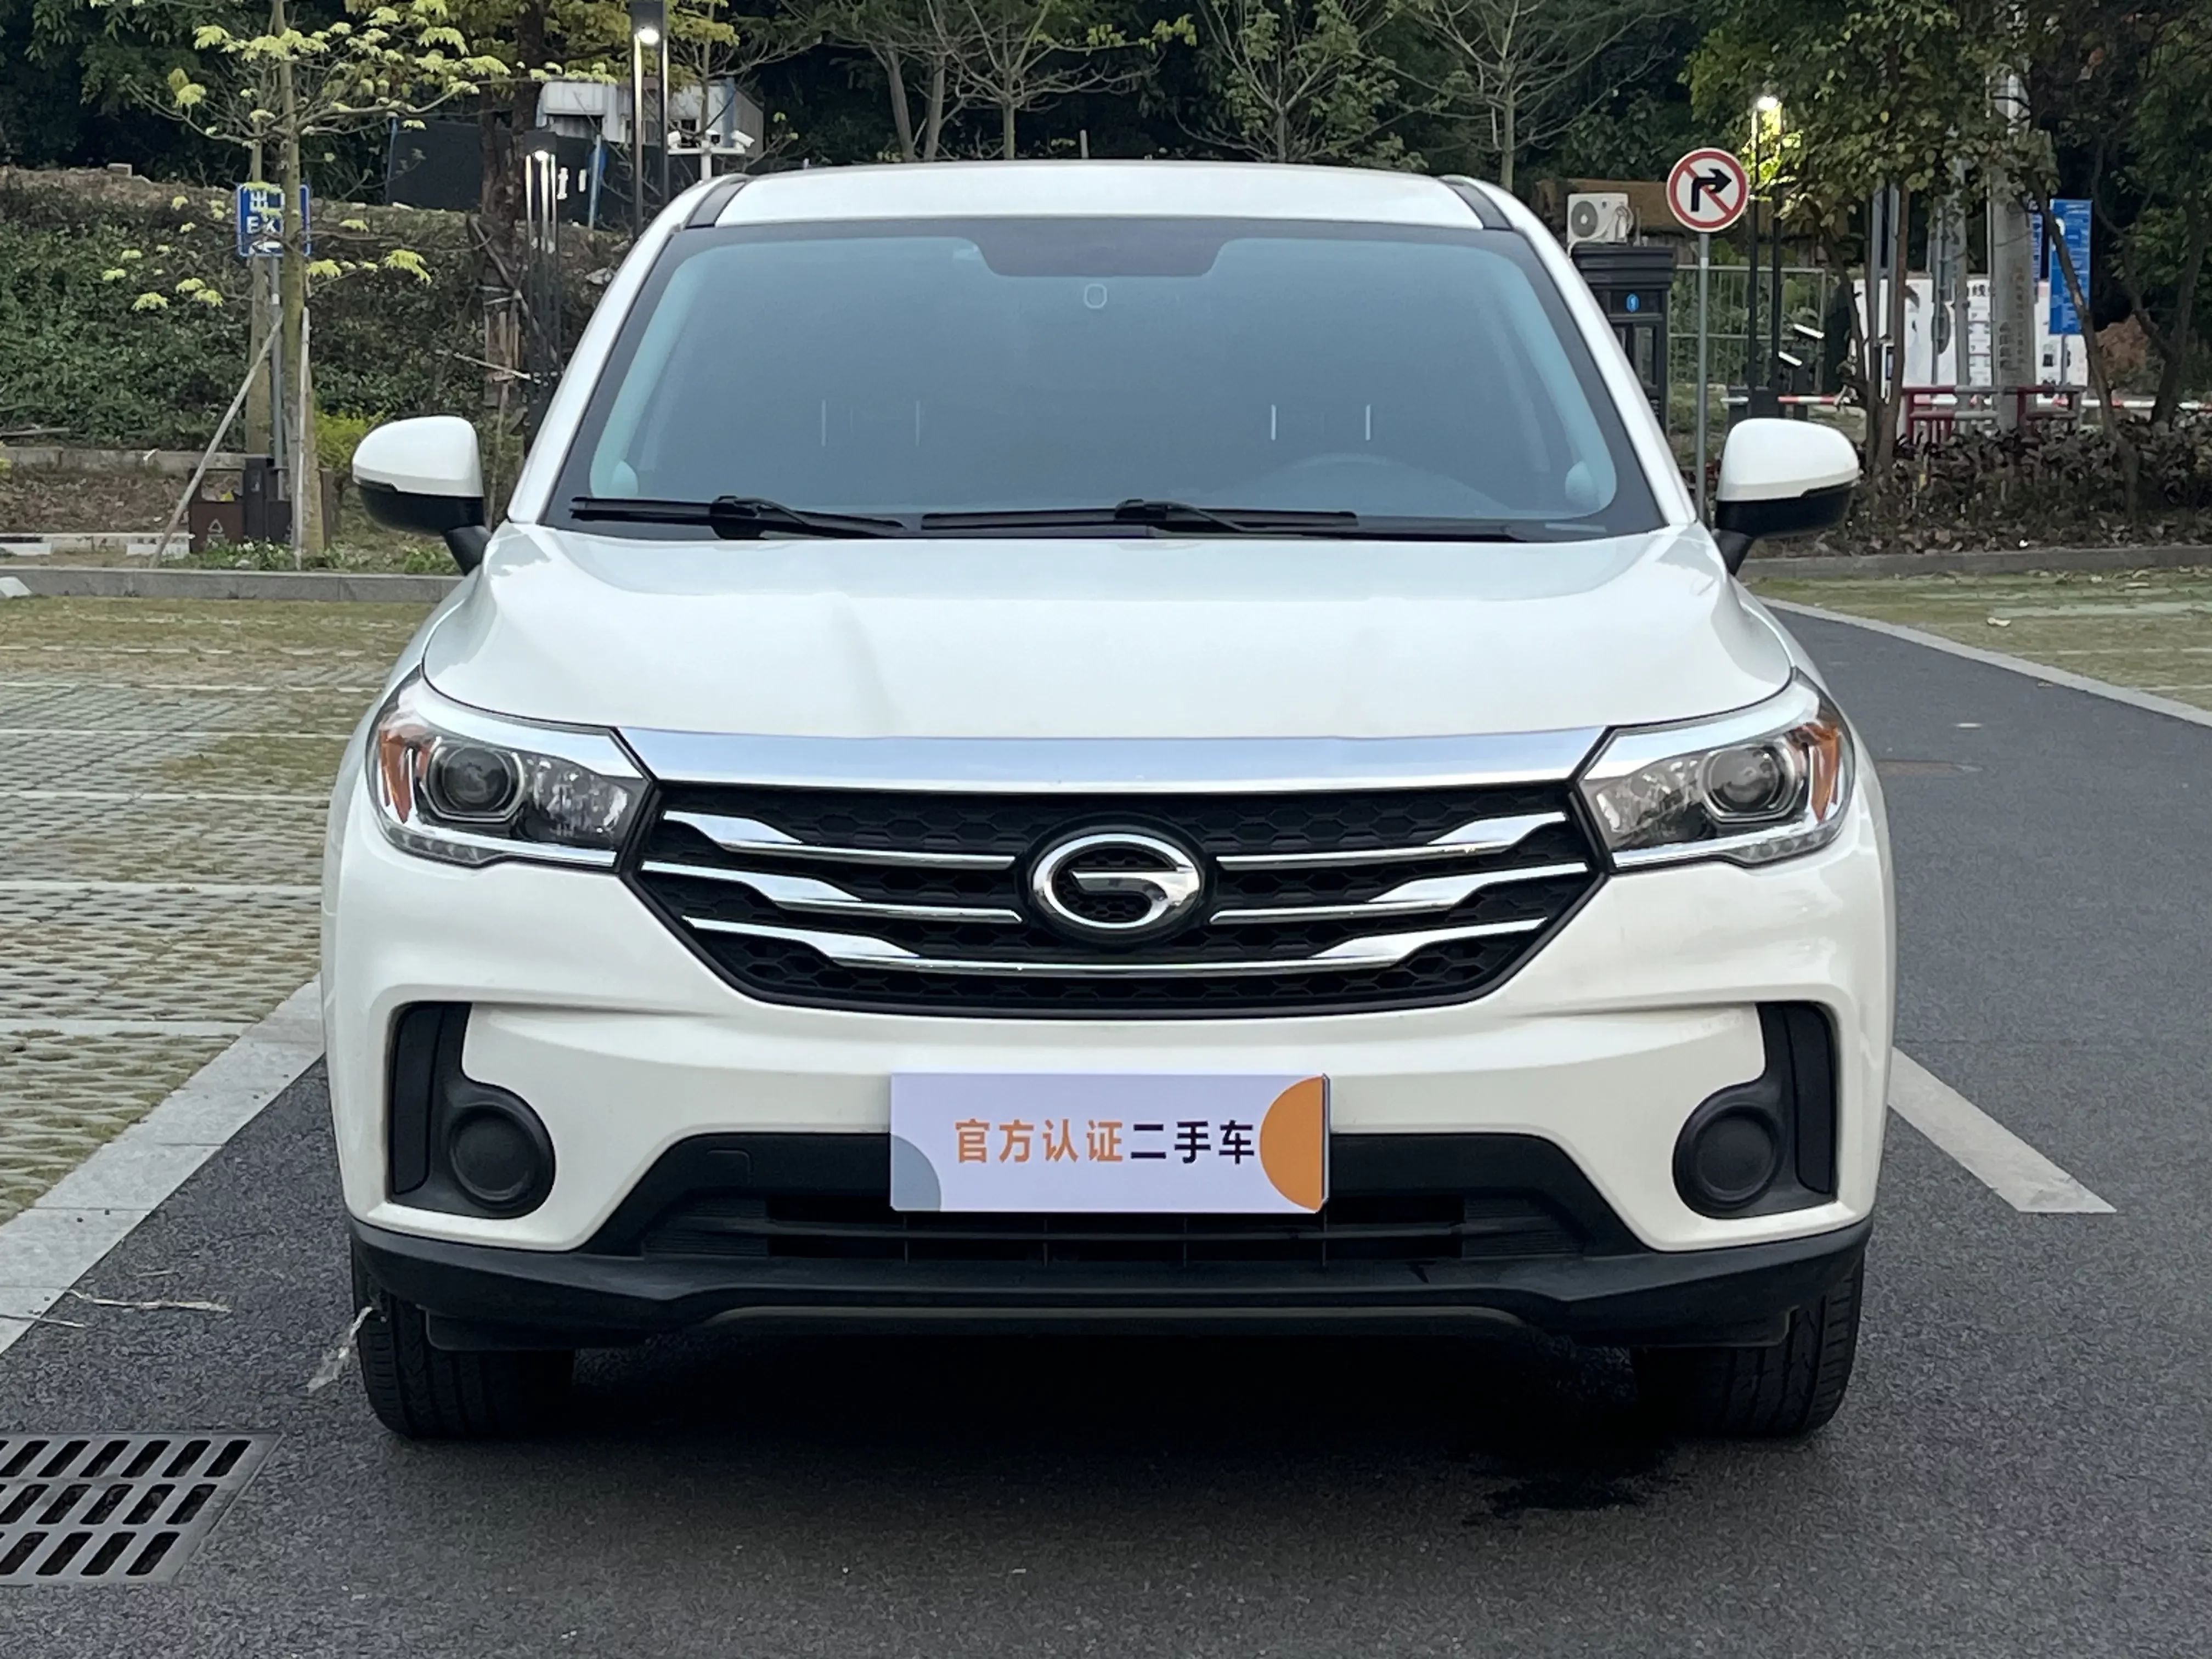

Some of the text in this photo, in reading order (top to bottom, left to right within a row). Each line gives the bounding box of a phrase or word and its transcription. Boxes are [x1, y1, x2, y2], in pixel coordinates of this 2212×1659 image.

[250, 190, 286, 213] 出
[955, 1119, 1255, 1165] 官方认证二手车
